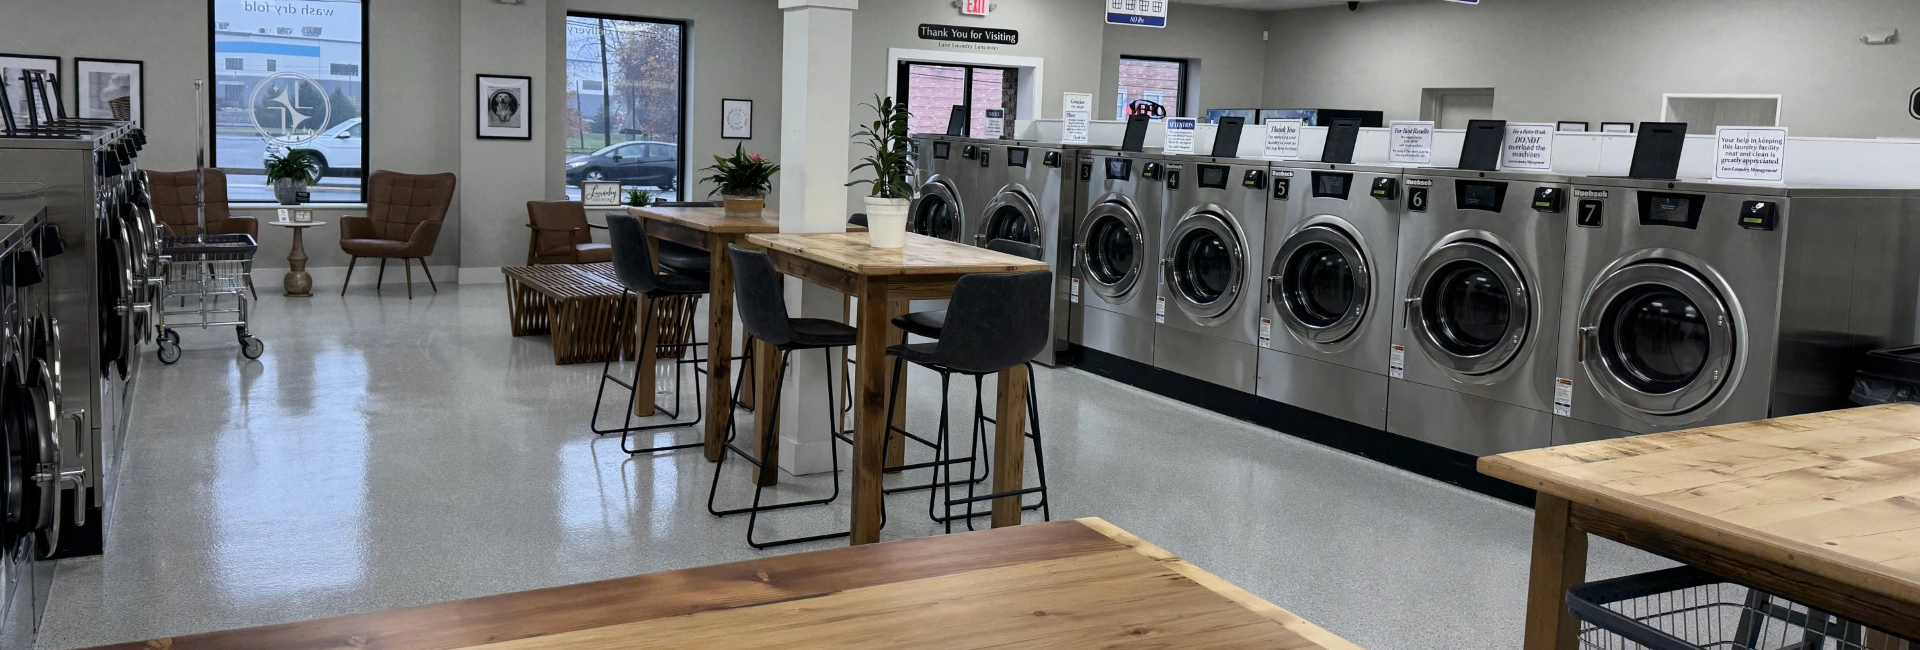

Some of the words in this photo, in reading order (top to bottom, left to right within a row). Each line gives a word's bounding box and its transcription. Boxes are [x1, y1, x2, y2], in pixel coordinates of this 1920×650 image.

[920, 26, 948, 38] Thank
[951, 28, 968, 39] You
[970, 29, 982, 40] for
[985, 31, 1016, 44] Visiting
[951, 42, 973, 50] Laundry
[1169, 121, 1194, 129] ATTENTION
[1514, 136, 1525, 144] DO
[1525, 136, 1541, 144] NOT
[1758, 137, 1783, 145] keeping
[1734, 143, 1757, 151] laundry
[982, 154, 987, 165] 2
[1083, 166, 1089, 177] 3
[1169, 173, 1176, 186] 4
[1277, 181, 1286, 196] 5
[1574, 189, 1608, 198] Huebsch
[1412, 191, 1422, 207] 6
[1584, 204, 1597, 223] 7
